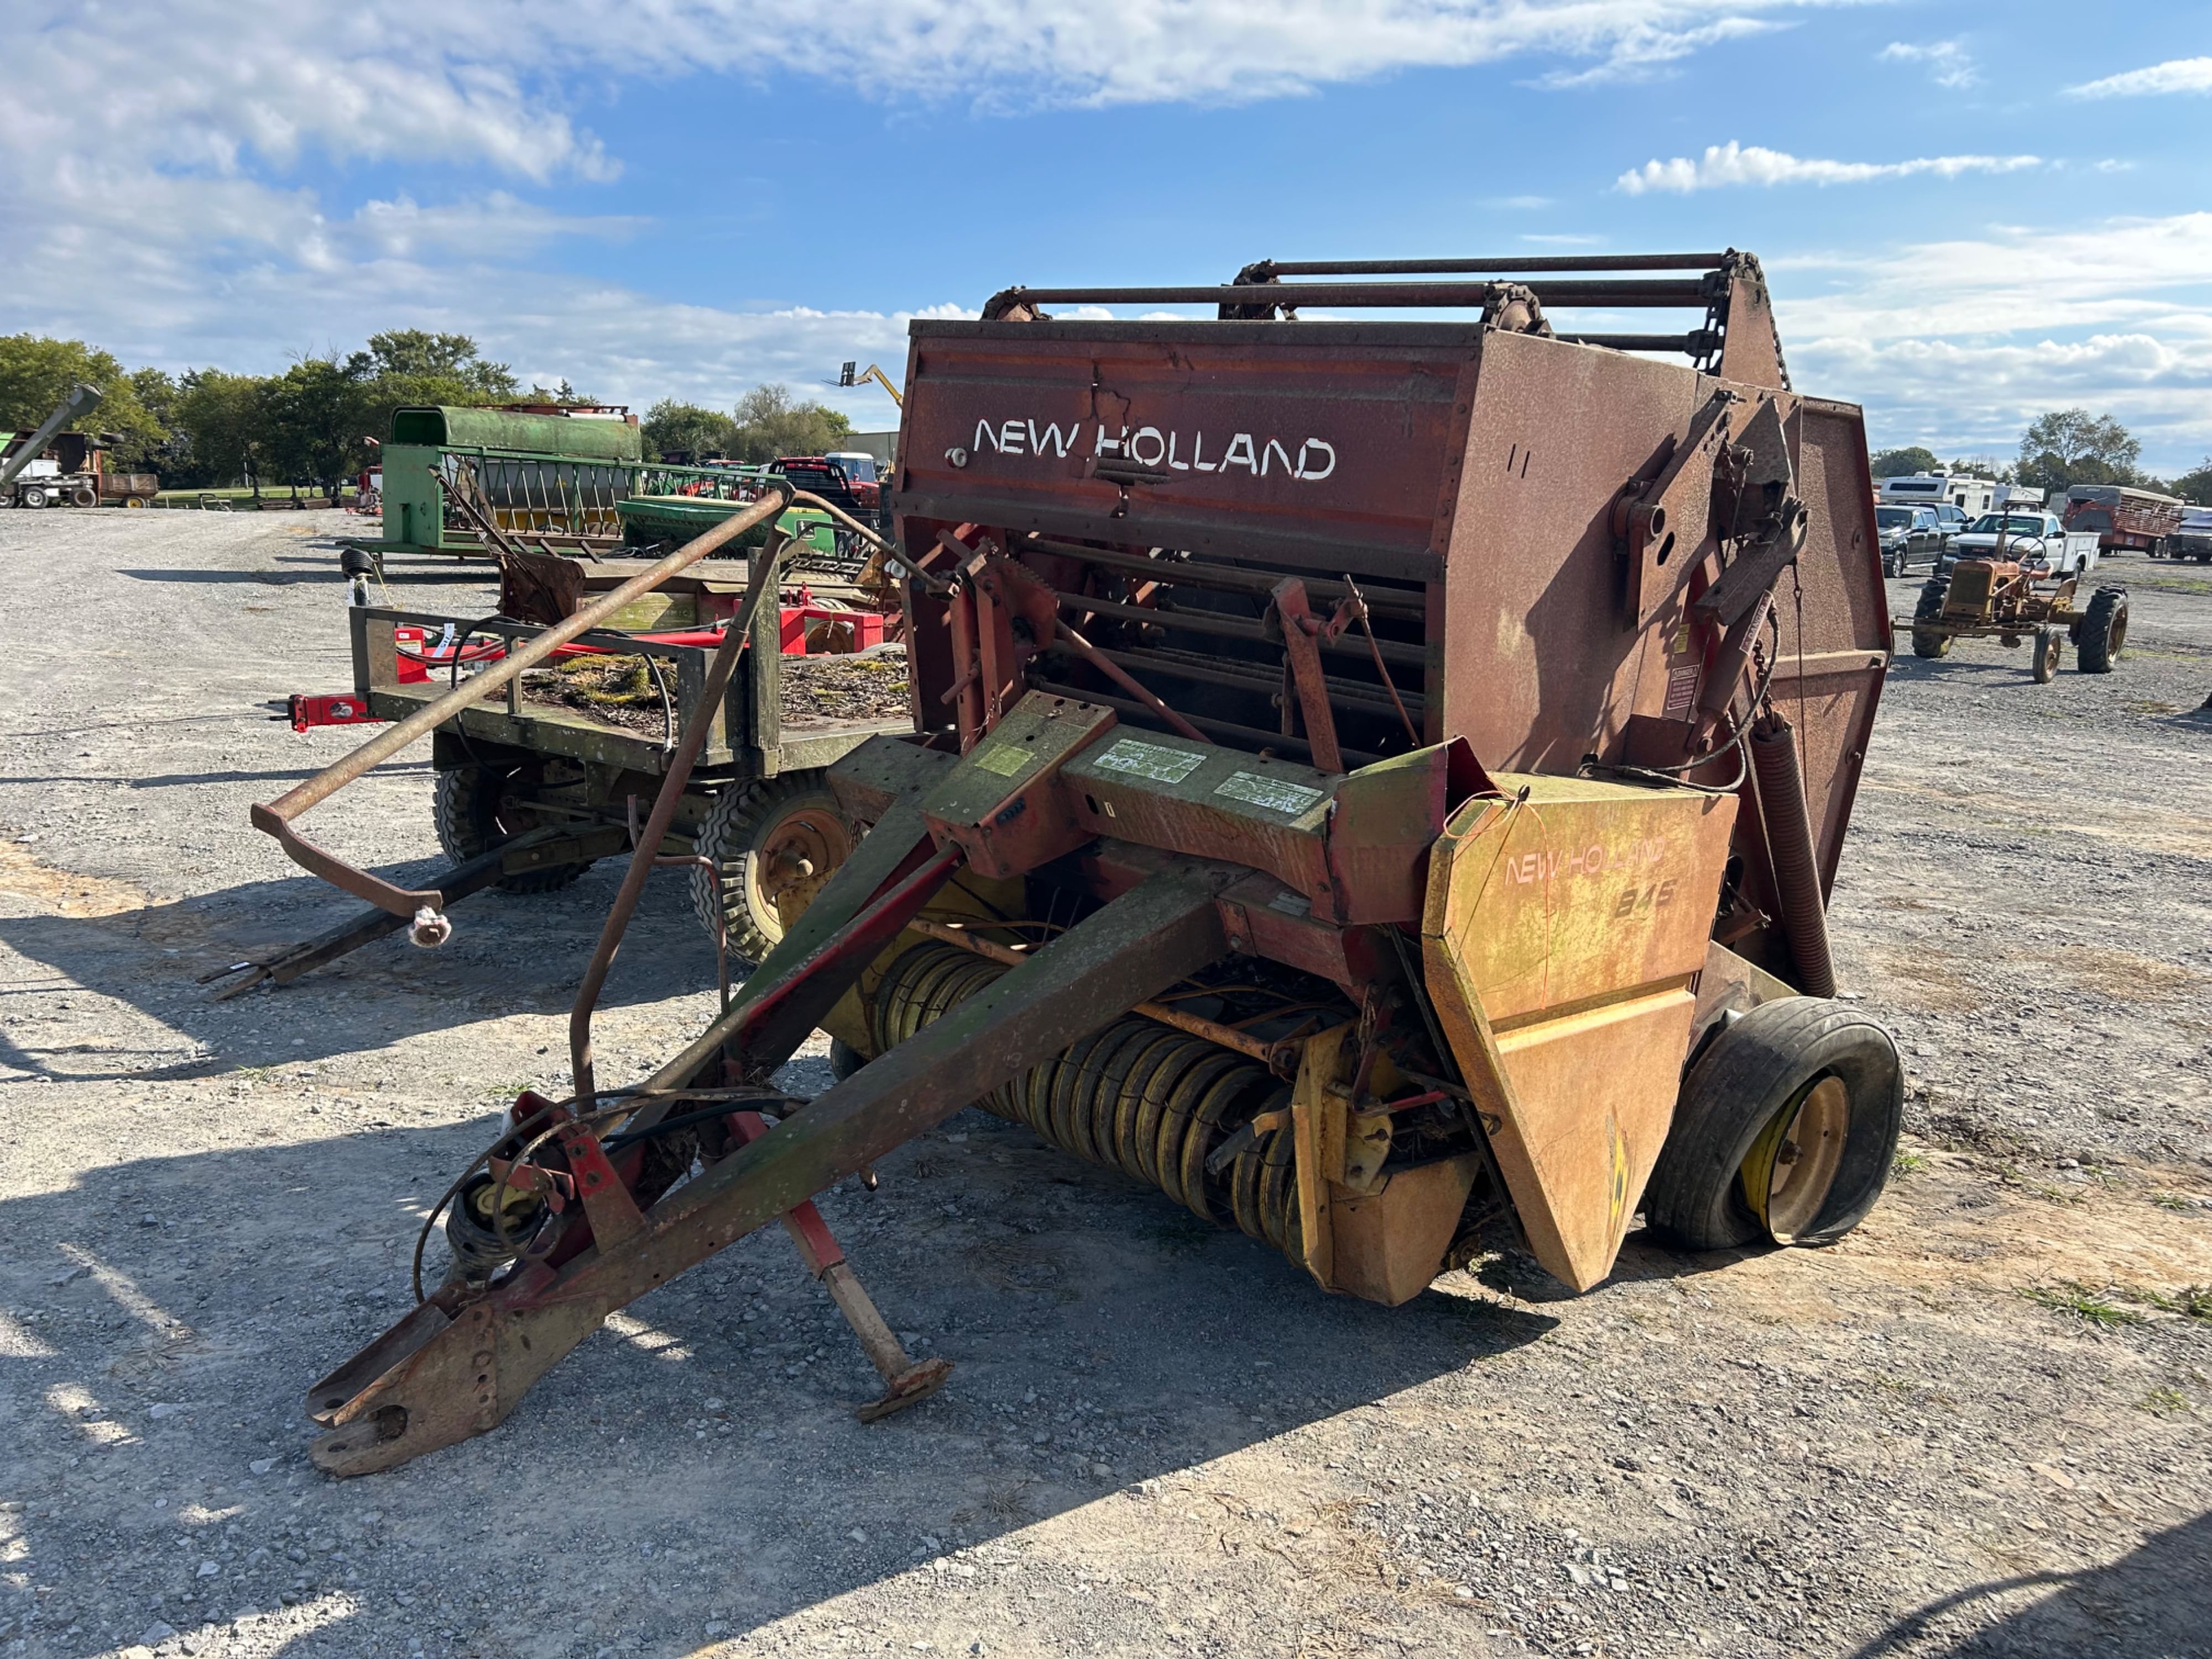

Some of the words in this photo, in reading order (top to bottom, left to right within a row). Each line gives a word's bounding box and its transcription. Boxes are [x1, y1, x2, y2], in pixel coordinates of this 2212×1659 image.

[973, 419, 1079, 458] NEW
[1095, 424, 1335, 479] HOLLAND
[1748, 604, 1767, 639] DANGER
[1505, 849, 1563, 885] NEW
[1568, 836, 1665, 876] HOLLAND
[1614, 879, 1678, 918] 846
